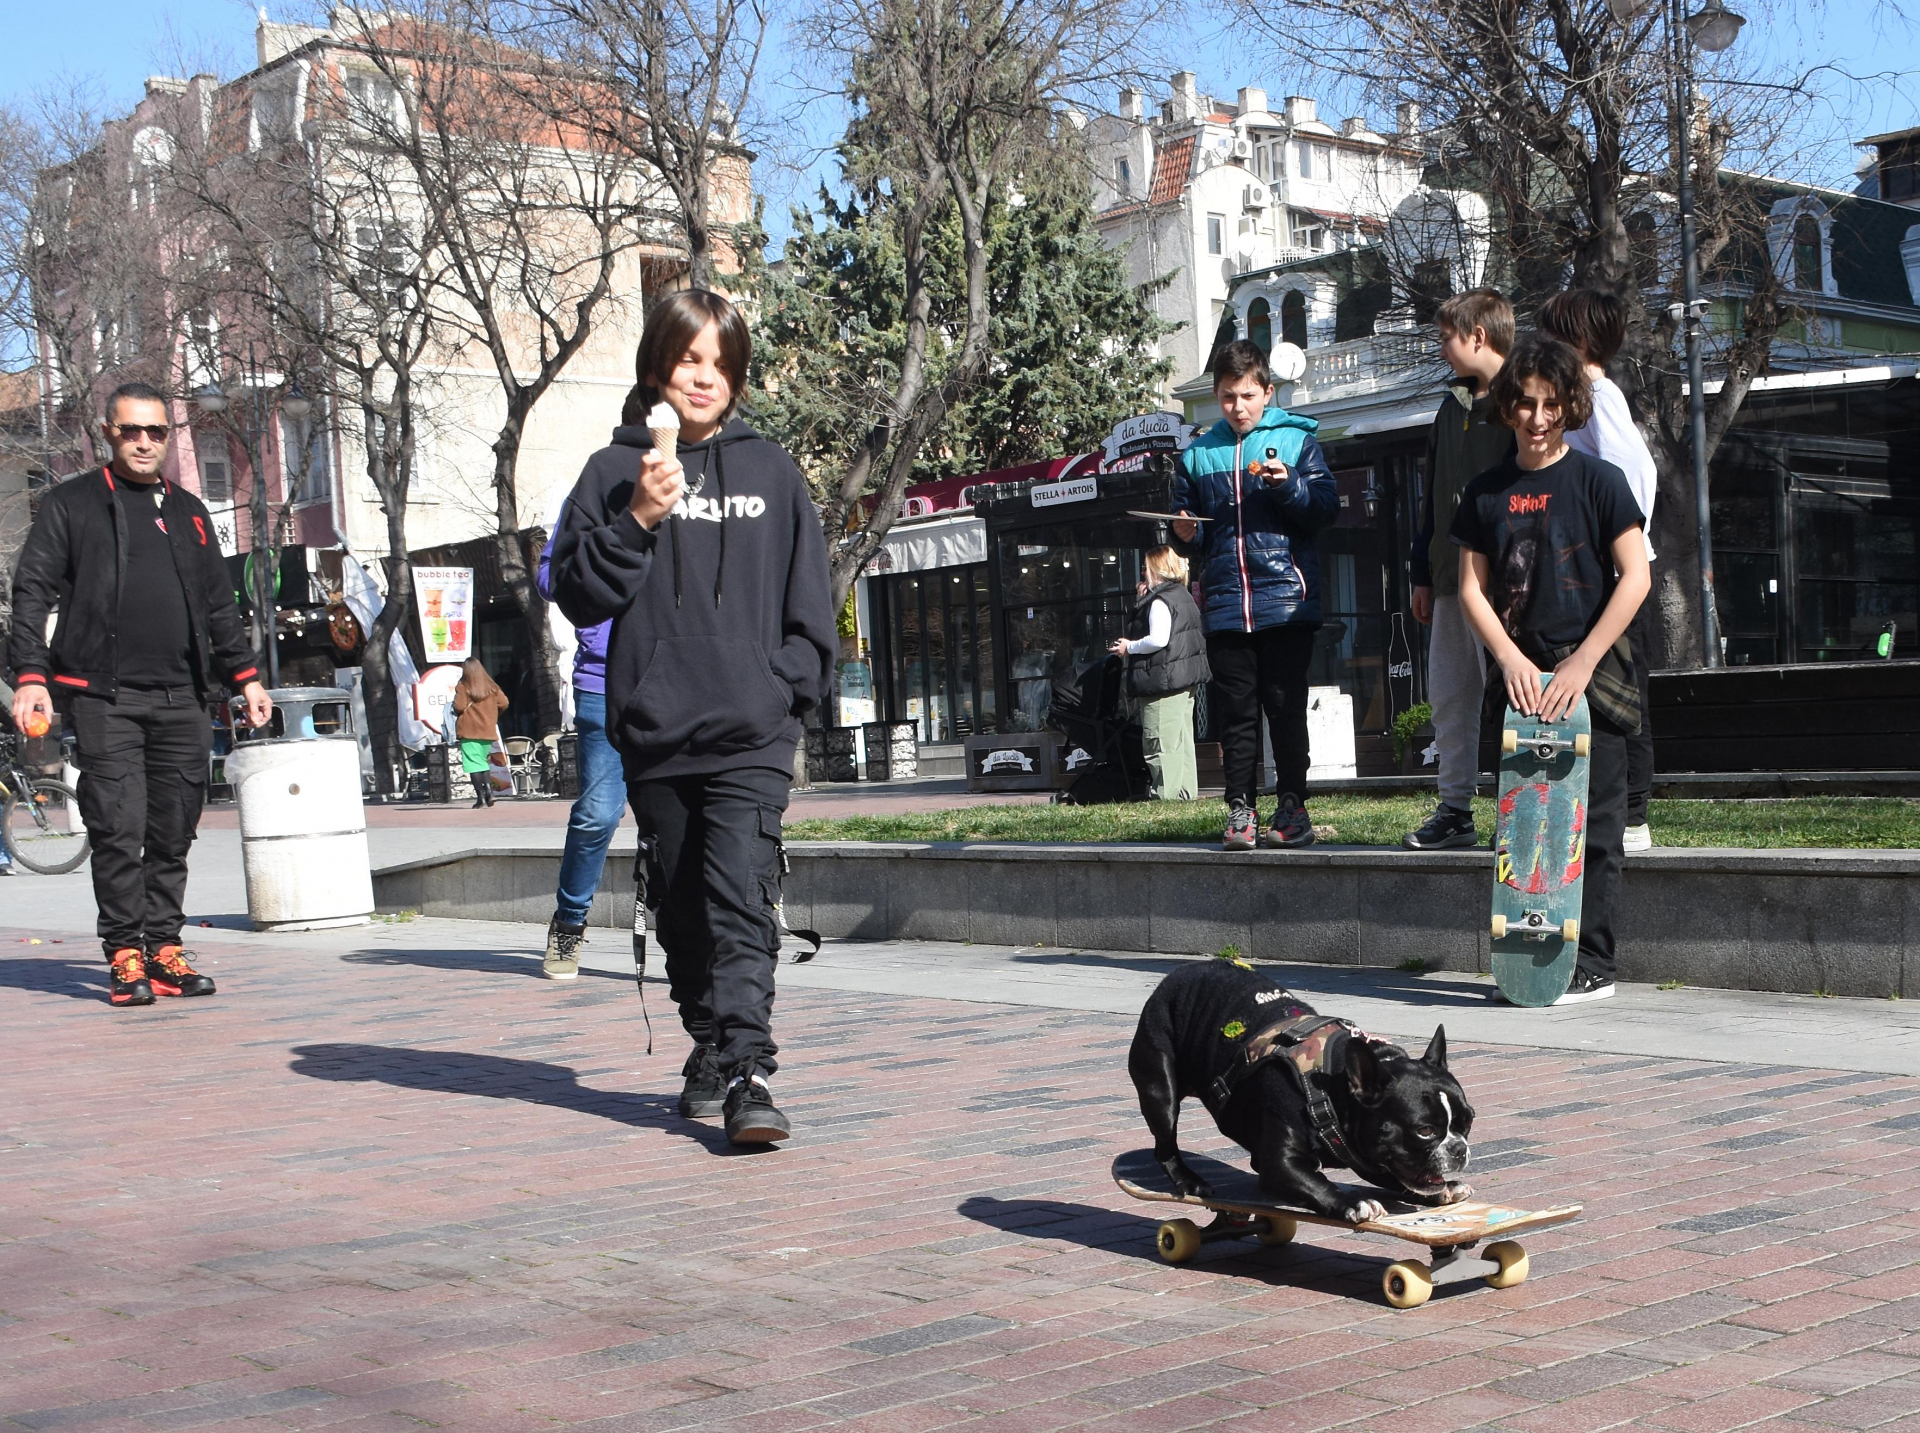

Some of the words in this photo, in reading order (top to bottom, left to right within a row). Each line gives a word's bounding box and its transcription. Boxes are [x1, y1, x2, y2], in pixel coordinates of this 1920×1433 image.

[1122, 423, 1136, 440] da
[1139, 418, 1171, 436] Lucio
[1152, 439, 1174, 449] Pizzeria
[1034, 489, 1060, 502] STELLA
[1067, 483, 1094, 496] ARTOIS
[668, 495, 766, 523] ARLITO
[418, 570, 451, 579] bubble
[453, 570, 470, 579] tea
[428, 694, 448, 706] GEL
[634, 900, 647, 936] FASHION
